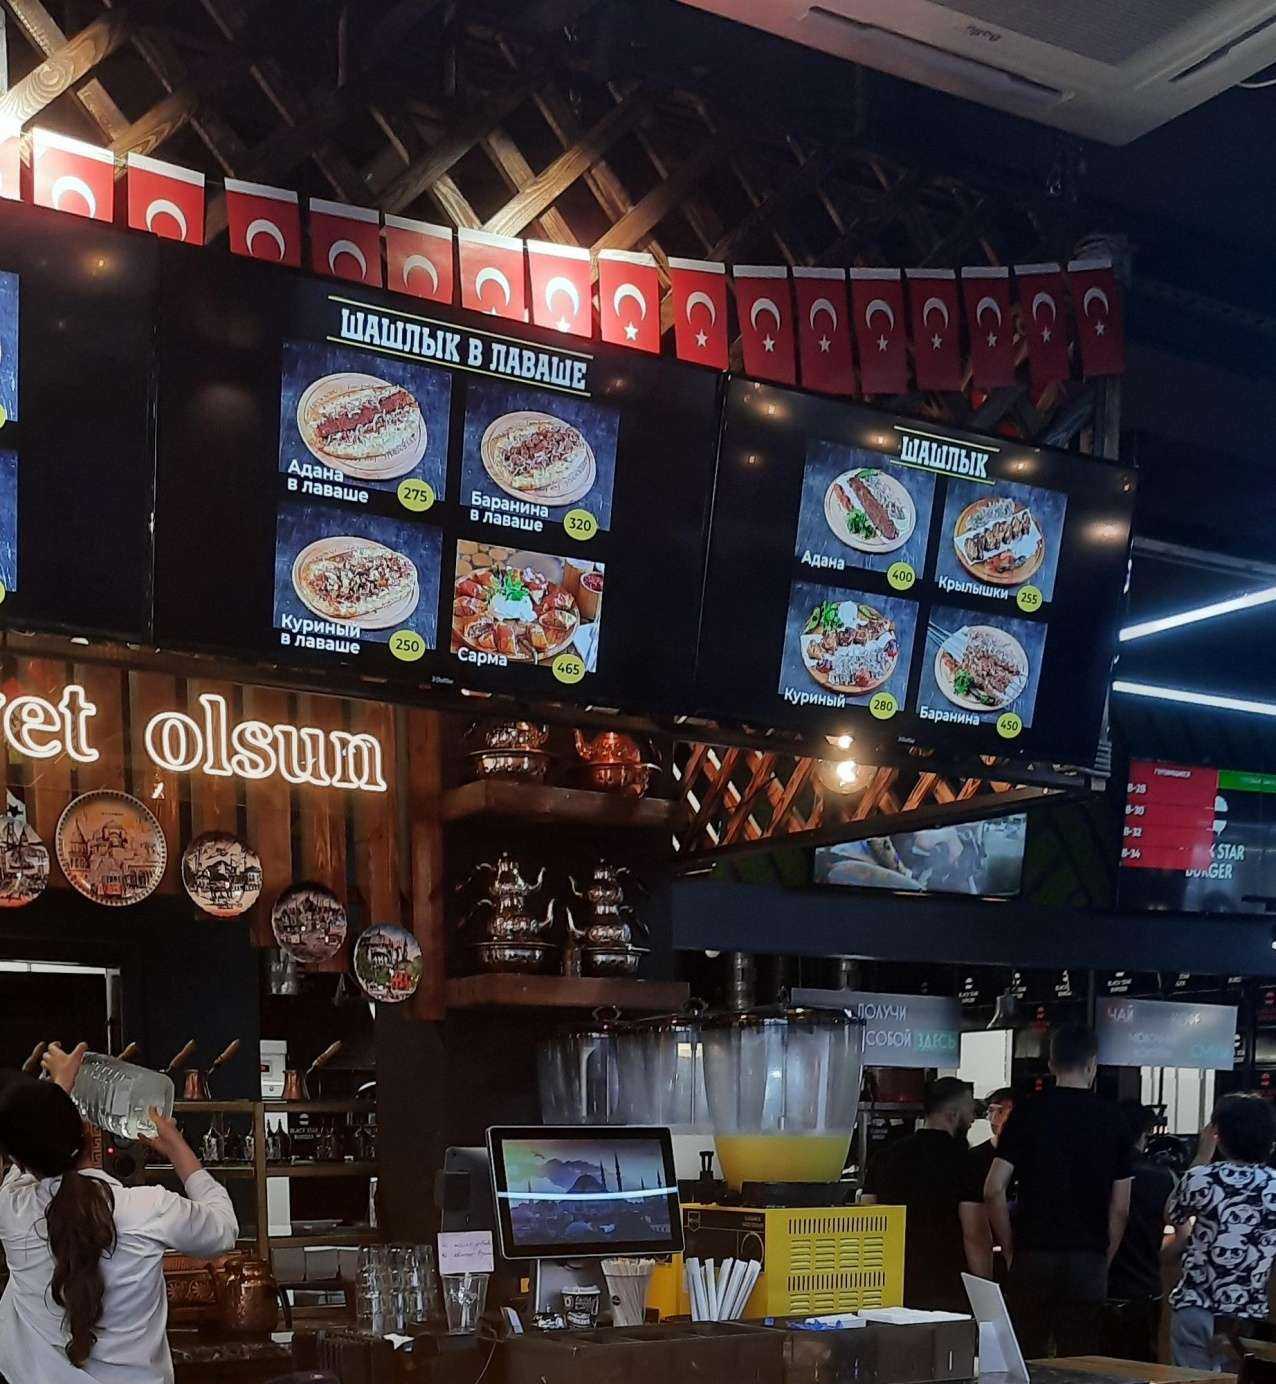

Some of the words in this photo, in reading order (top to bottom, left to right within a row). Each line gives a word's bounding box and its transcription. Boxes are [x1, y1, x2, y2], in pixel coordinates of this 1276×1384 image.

[340, 308, 461, 363] ШАШЛЫК
[468, 338, 483, 367] В
[490, 343, 588, 390] ЛАВАШЕ
[901, 435, 989, 478] ШАШЛЫК
[288, 459, 344, 482] Адана
[287, 478, 297, 491] в
[302, 480, 369, 503] лаваше
[403, 487, 427, 502] 275
[471, 491, 549, 518] Баранина
[470, 509, 479, 521] в
[483, 511, 544, 532] лаваше
[569, 517, 591, 532] 320
[801, 550, 845, 570] Адана
[892, 570, 913, 583] 400
[939, 576, 1009, 599] Крылышки
[1020, 592, 1038, 605] 255
[281, 614, 361, 638] Куриный
[280, 632, 291, 645] в
[294, 634, 360, 655] лаваше
[395, 638, 419, 652] 250
[457, 646, 508, 666] Сарма
[557, 663, 580, 676] 465
[784, 687, 846, 709] Куриный
[873, 700, 893, 712] 280
[919, 705, 980, 727] Баранина
[999, 719, 1019, 732] 450
[0, 684, 99, 763] et
[145, 693, 388, 793] olsun
[1217, 843, 1245, 861] STAR
[858, 1002, 907, 1021] ПОЛУЧИ
[865, 1028, 911, 1047] СОБОЙ
